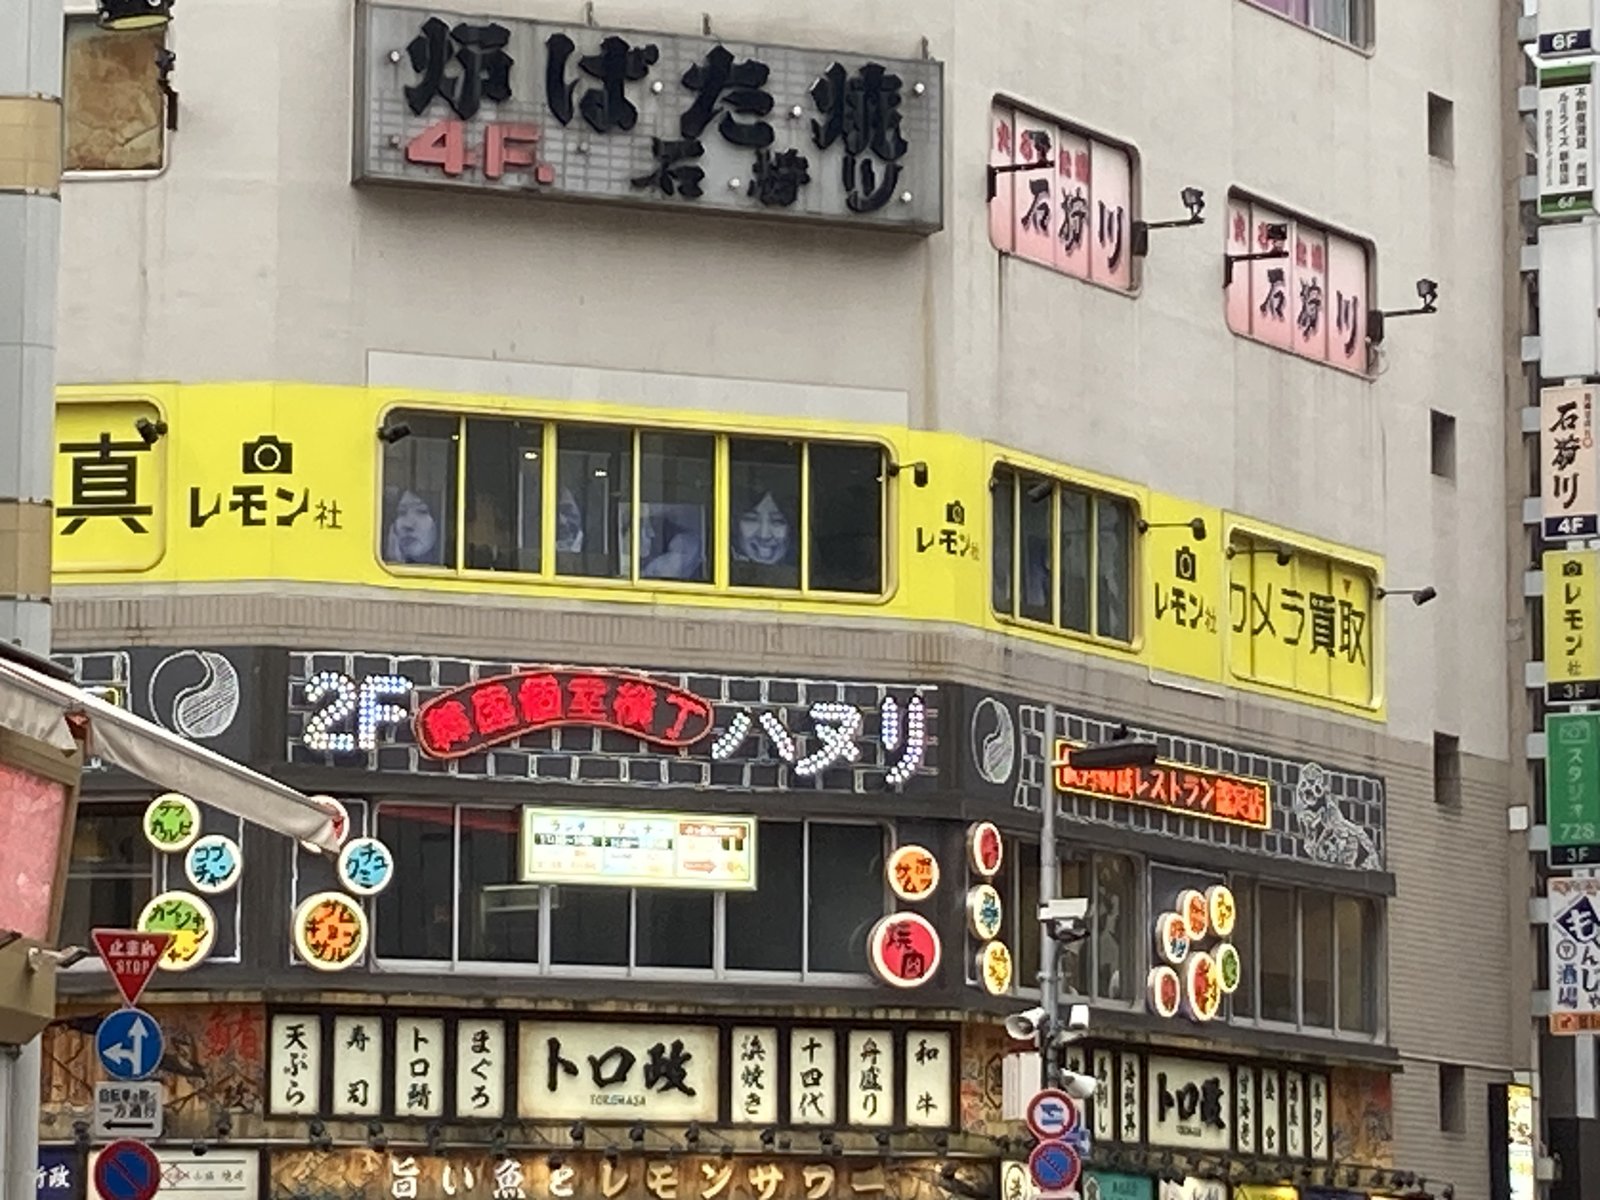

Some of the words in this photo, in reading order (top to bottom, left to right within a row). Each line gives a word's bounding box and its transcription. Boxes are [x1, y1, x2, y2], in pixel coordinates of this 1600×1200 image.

[1552, 33, 1578, 49] 6F
[1021, 178, 1124, 274] 石狩川
[1260, 267, 1358, 358] 石狩川
[1549, 401, 1581, 509] 石狩川
[190, 485, 342, 529] レモン社
[1557, 518, 1584, 535] 4F
[1154, 582, 1217, 634] レモン社
[1563, 582, 1583, 676] レモン社
[304, 671, 413, 752] 2F
[1563, 683, 1585, 699] 3F
[711, 696, 927, 785] ハヌリ
[1566, 846, 1589, 862] 3F
[108, 938, 158, 957] 止まれ
[115, 959, 151, 975] STOP
[347, 1024, 370, 1107] 寿司
[471, 1030, 492, 1109] まぐろ
[799, 1036, 825, 1119] 十四代
[914, 1038, 940, 1118] 和牛
